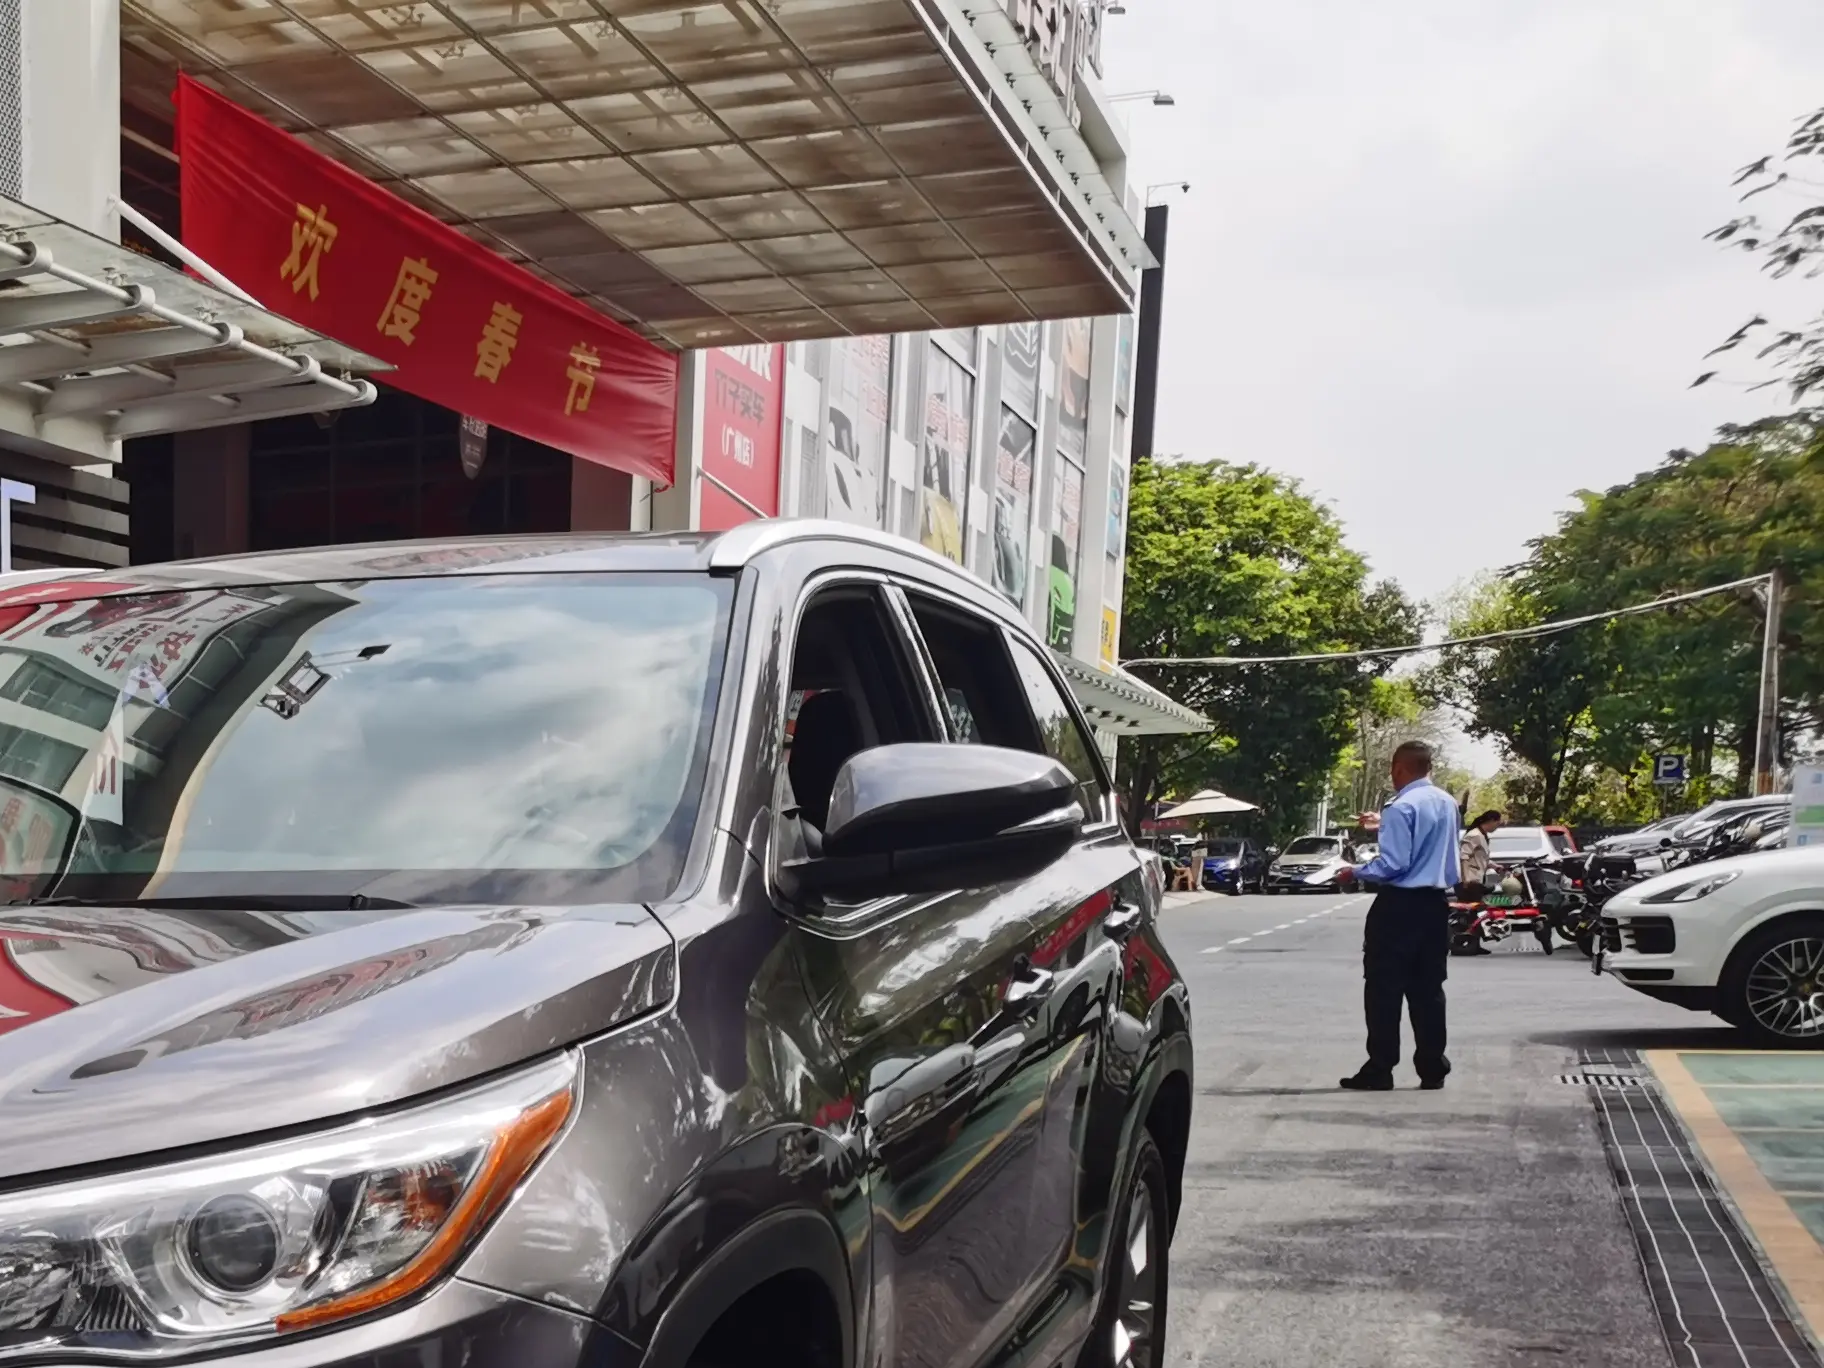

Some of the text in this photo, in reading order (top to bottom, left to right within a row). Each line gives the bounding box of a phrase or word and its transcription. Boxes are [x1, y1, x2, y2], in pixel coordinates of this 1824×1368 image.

[280, 202, 601, 416] 欢度春节
[1658, 757, 1679, 777] P
